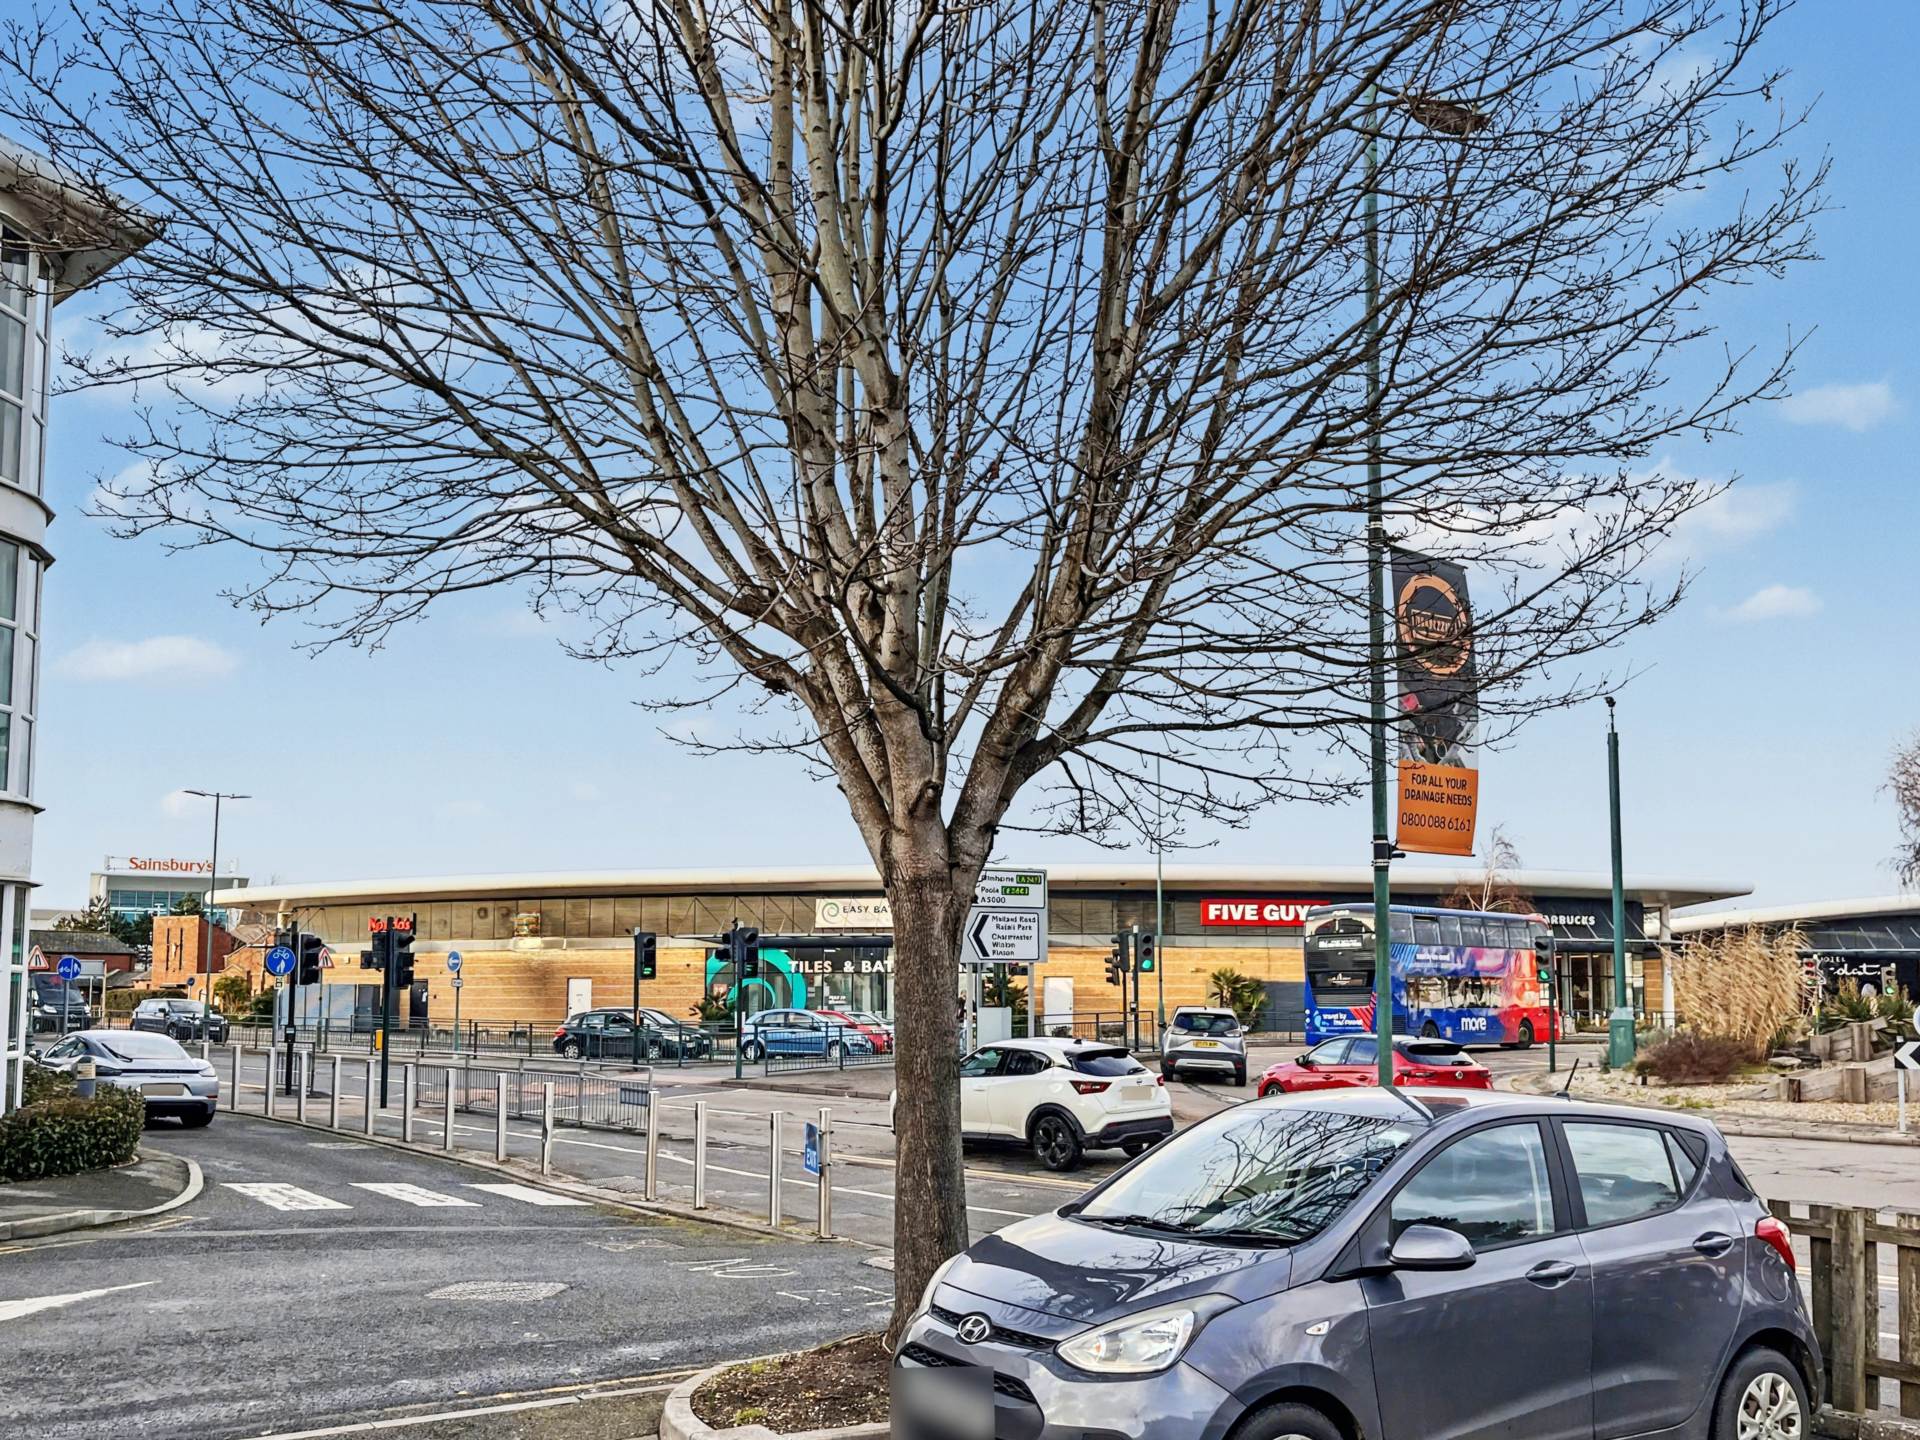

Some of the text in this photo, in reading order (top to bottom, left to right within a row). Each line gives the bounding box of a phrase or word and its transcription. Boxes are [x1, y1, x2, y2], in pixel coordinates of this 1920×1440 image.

[1411, 773, 1467, 790] FOR ALL YOUR
[1404, 788, 1472, 807] DRAINAGE NEEDS
[1401, 812, 1471, 832] 0800 088 6161
[129, 857, 214, 874] Sainsbury's
[843, 906, 890, 914] EASY BA
[1208, 904, 1258, 921] FIVE
[1263, 904, 1317, 921] GUY
[1542, 915, 1596, 926] ARBUCKS
[788, 960, 833, 973] TILES
[843, 960, 855, 973] &
[1461, 1016, 1487, 1031] more
